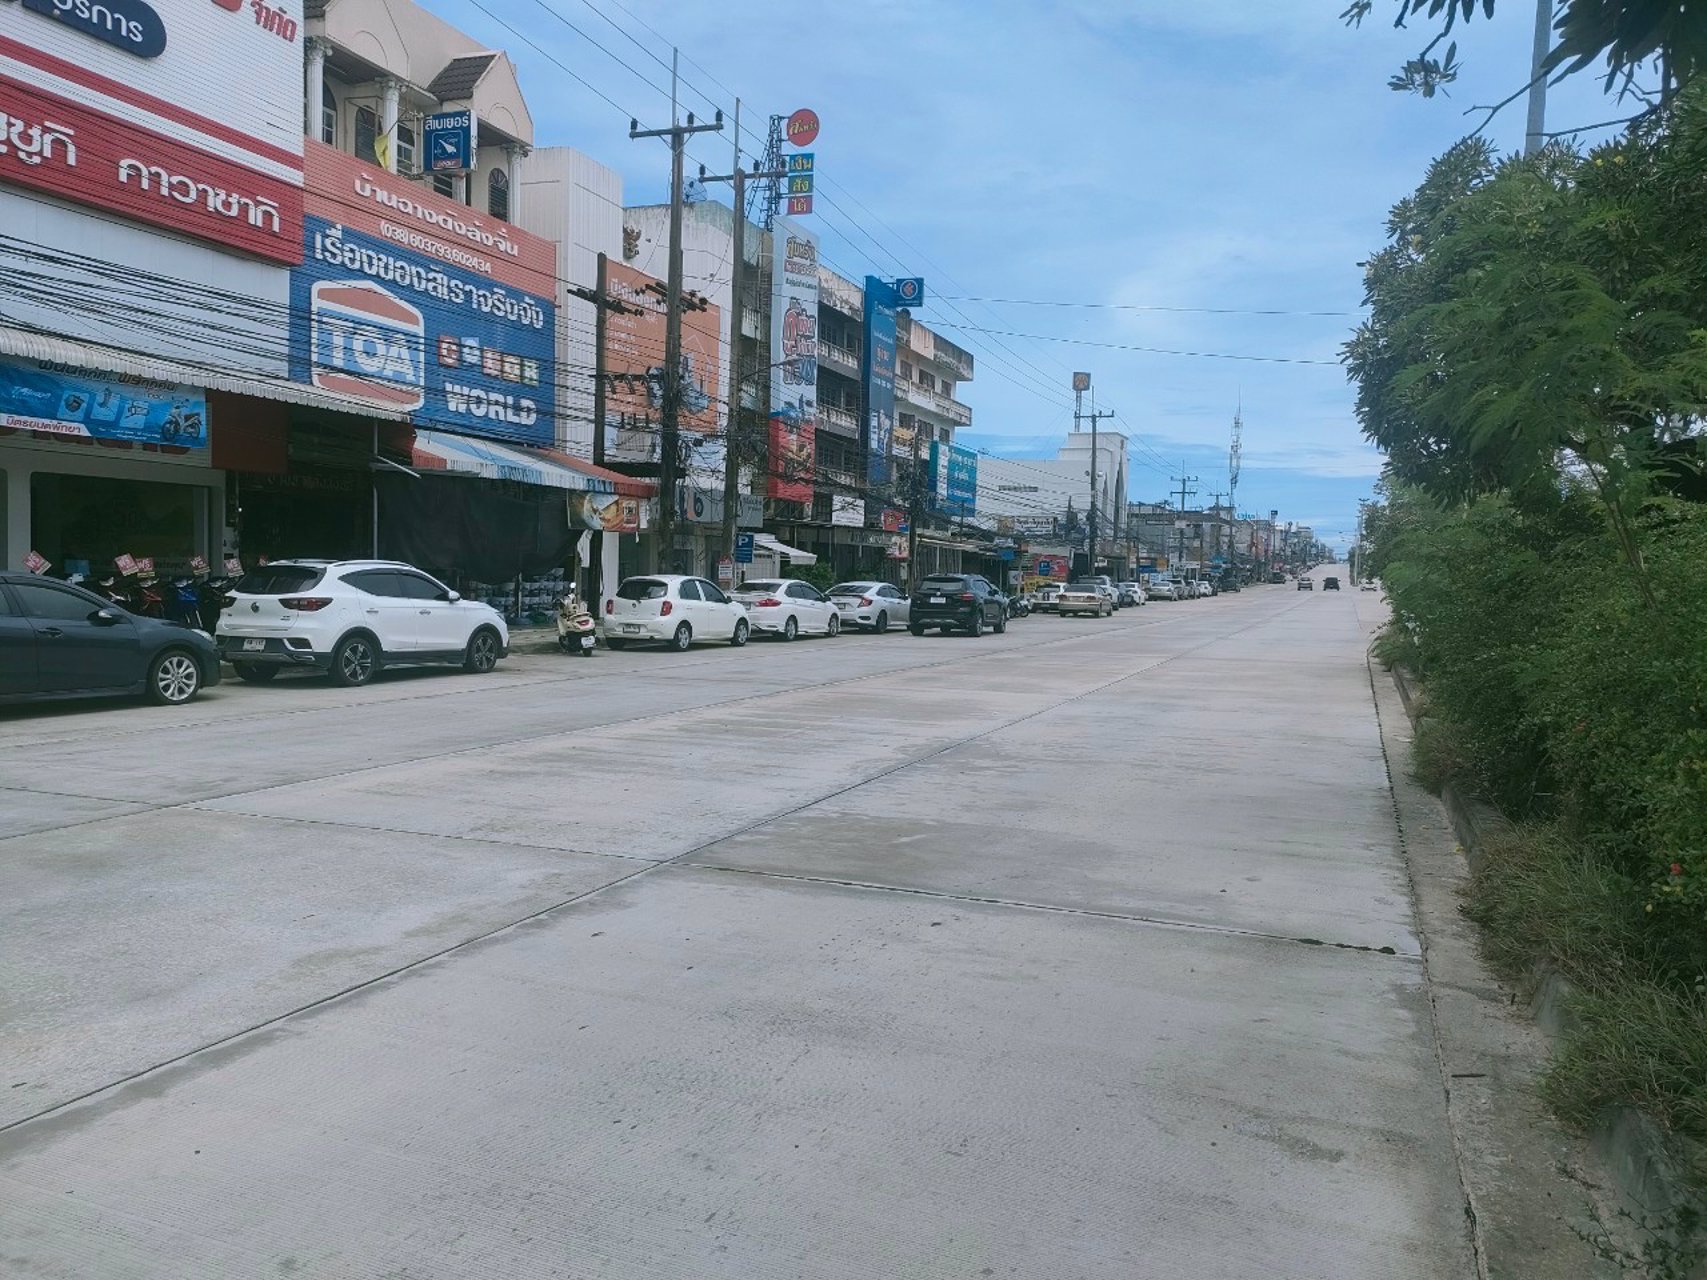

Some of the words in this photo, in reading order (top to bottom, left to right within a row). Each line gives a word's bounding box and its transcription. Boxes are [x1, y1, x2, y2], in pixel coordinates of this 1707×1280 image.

[321, 317, 417, 381] TOA
[444, 381, 537, 426] WORLD
[738, 536, 749, 546] P
